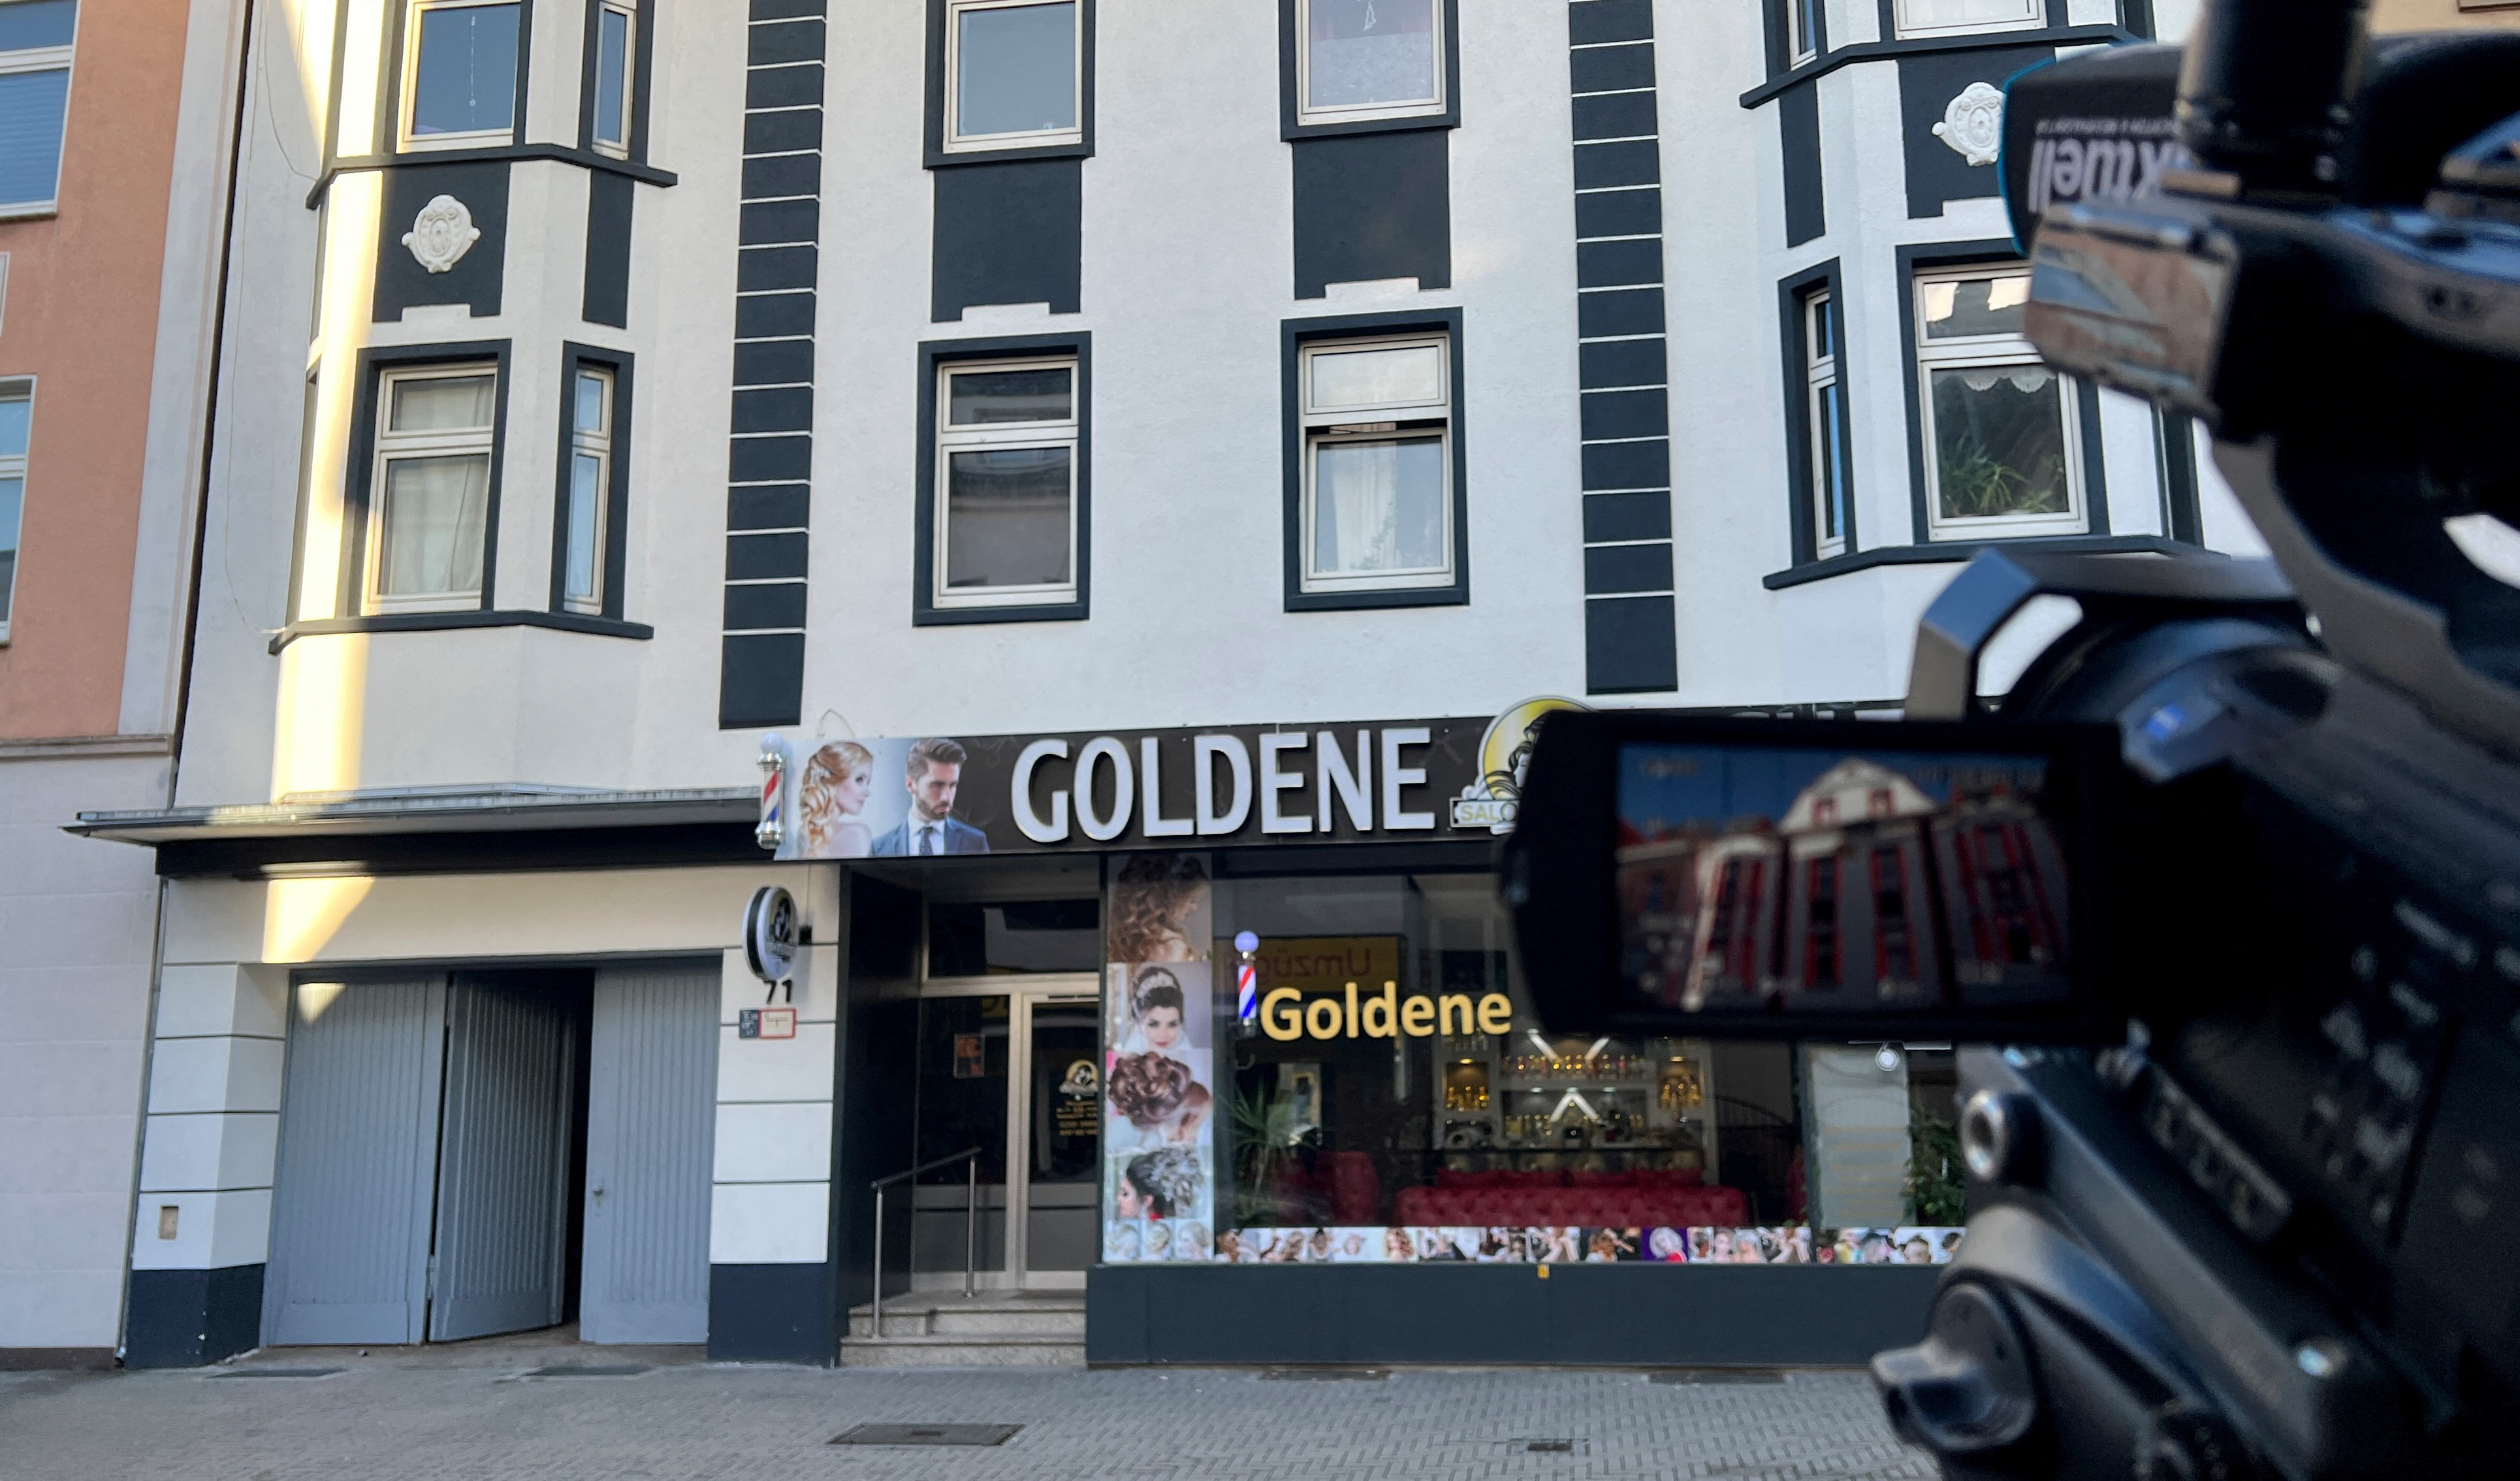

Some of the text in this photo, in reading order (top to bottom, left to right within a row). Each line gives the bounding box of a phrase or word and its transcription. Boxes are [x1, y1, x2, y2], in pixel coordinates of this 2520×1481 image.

[1012, 727, 1435, 843] GOLDENE
[1460, 803, 1517, 821] SALO
[763, 978, 793, 1004] 71
[1260, 981, 1512, 1042] Goldene
